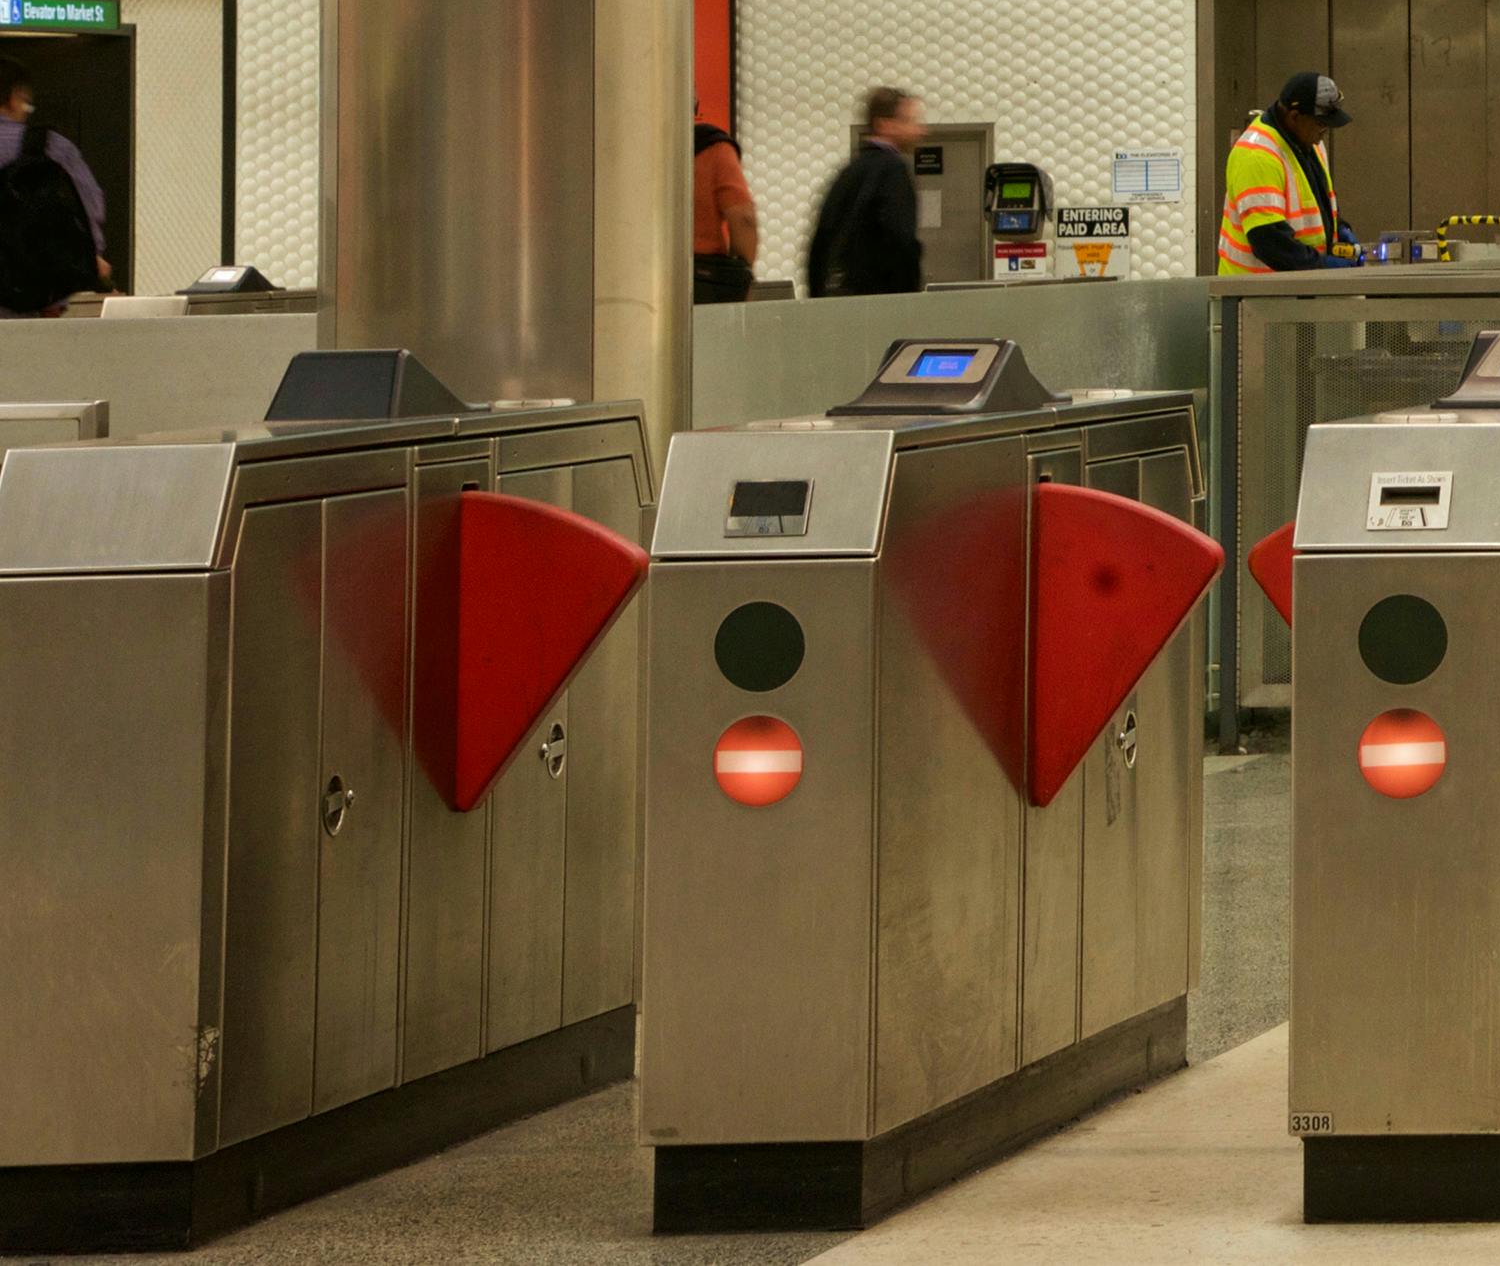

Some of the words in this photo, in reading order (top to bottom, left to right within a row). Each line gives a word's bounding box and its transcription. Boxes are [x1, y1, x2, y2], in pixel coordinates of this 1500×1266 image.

[23, 2, 56, 19] Elevator
[56, 5, 66, 20] to
[66, 3, 94, 21] Market
[95, 5, 104, 22] St
[1062, 210, 1124, 222] ENTERING
[1058, 223, 1087, 236] PAID
[1092, 223, 1127, 235] AREA
[1292, 1116, 1330, 1131] 3308
